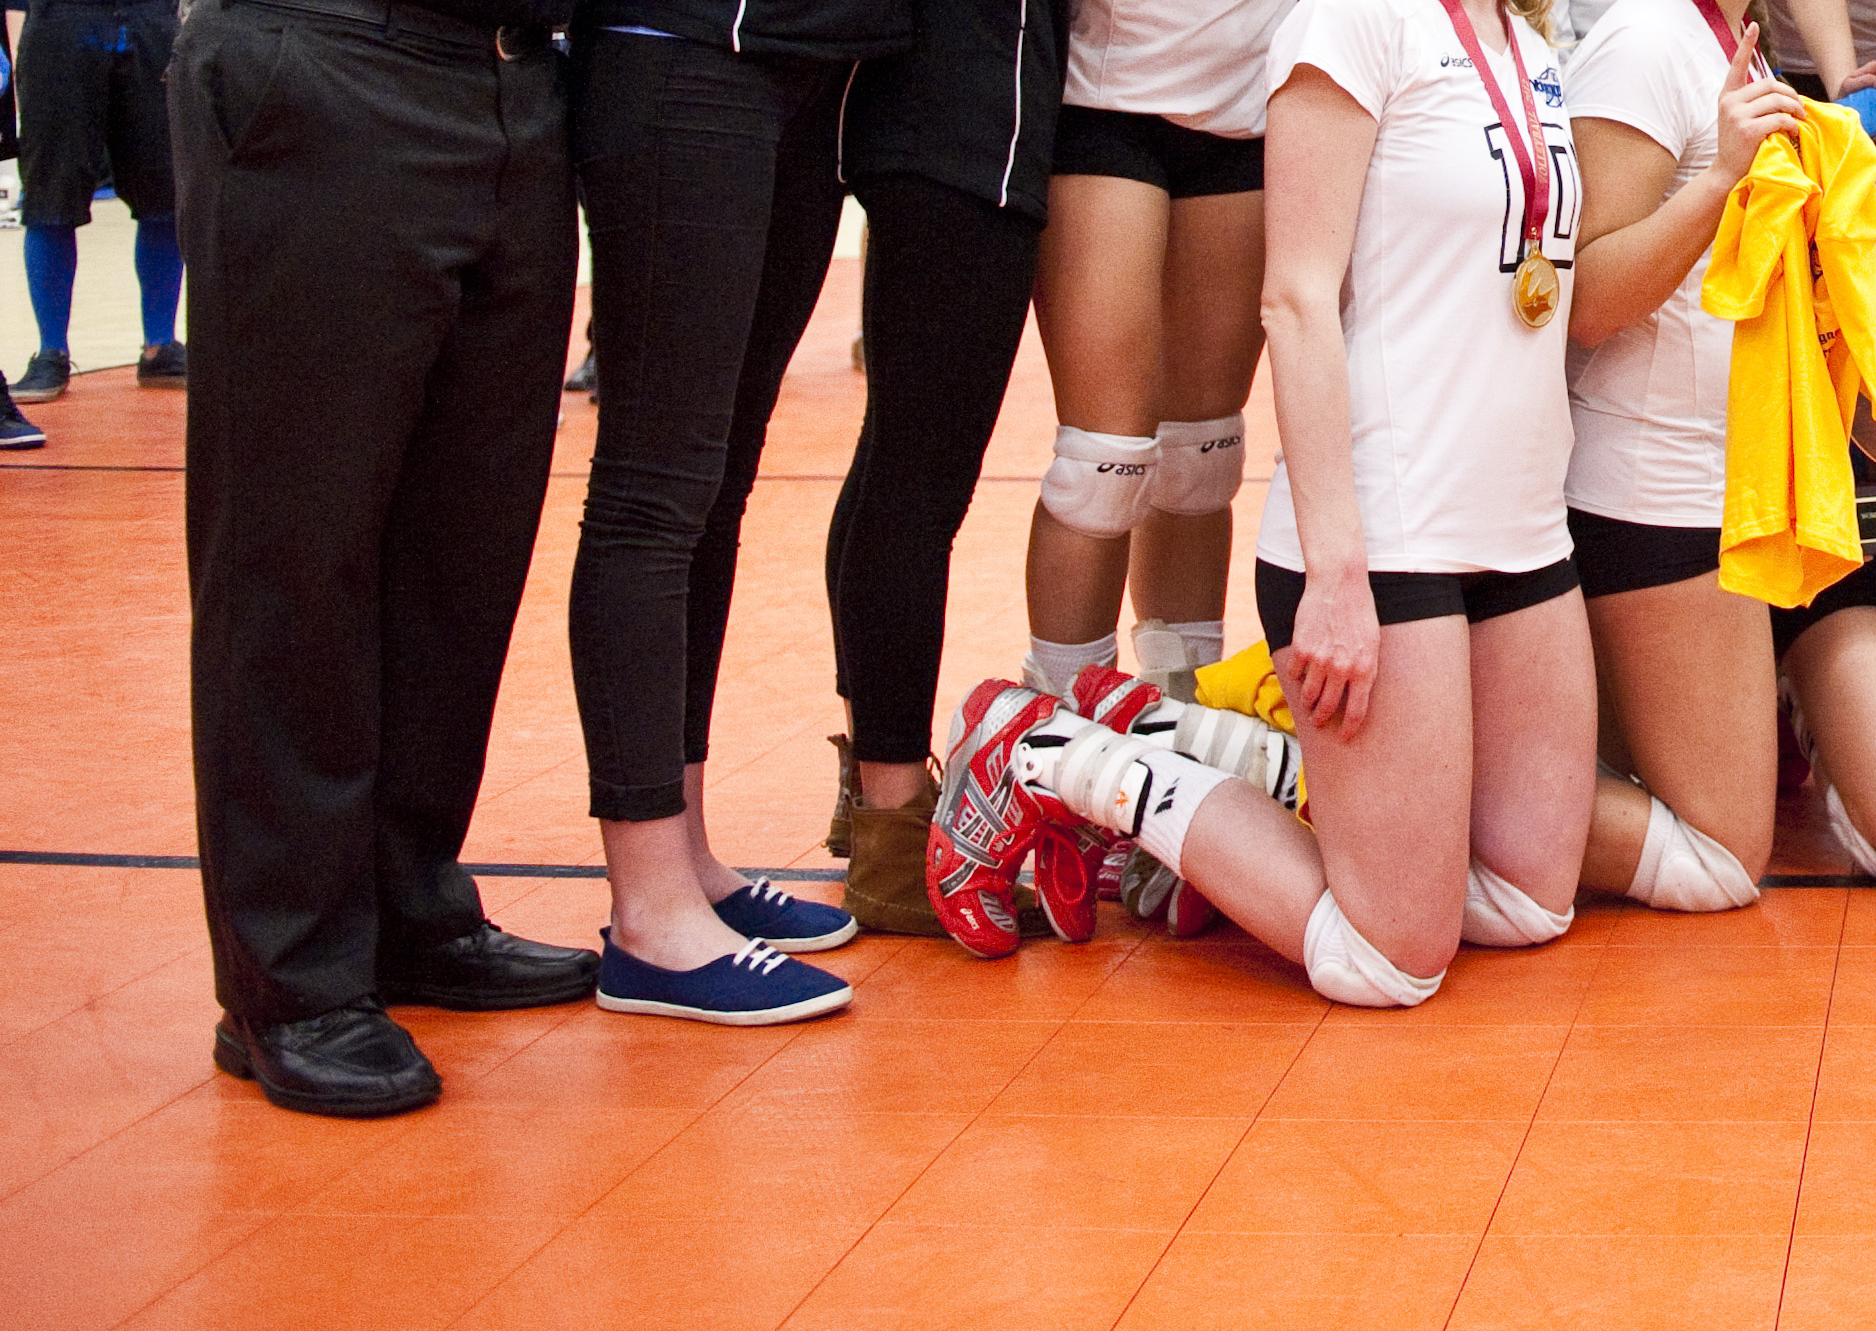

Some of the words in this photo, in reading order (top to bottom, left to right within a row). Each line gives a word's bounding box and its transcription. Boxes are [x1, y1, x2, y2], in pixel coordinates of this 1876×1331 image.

[1528, 111, 1549, 184] VOLLEYBALL
[1484, 121, 1583, 273] 10
[1216, 436, 1241, 450] asics
[1115, 464, 1146, 476] asics
